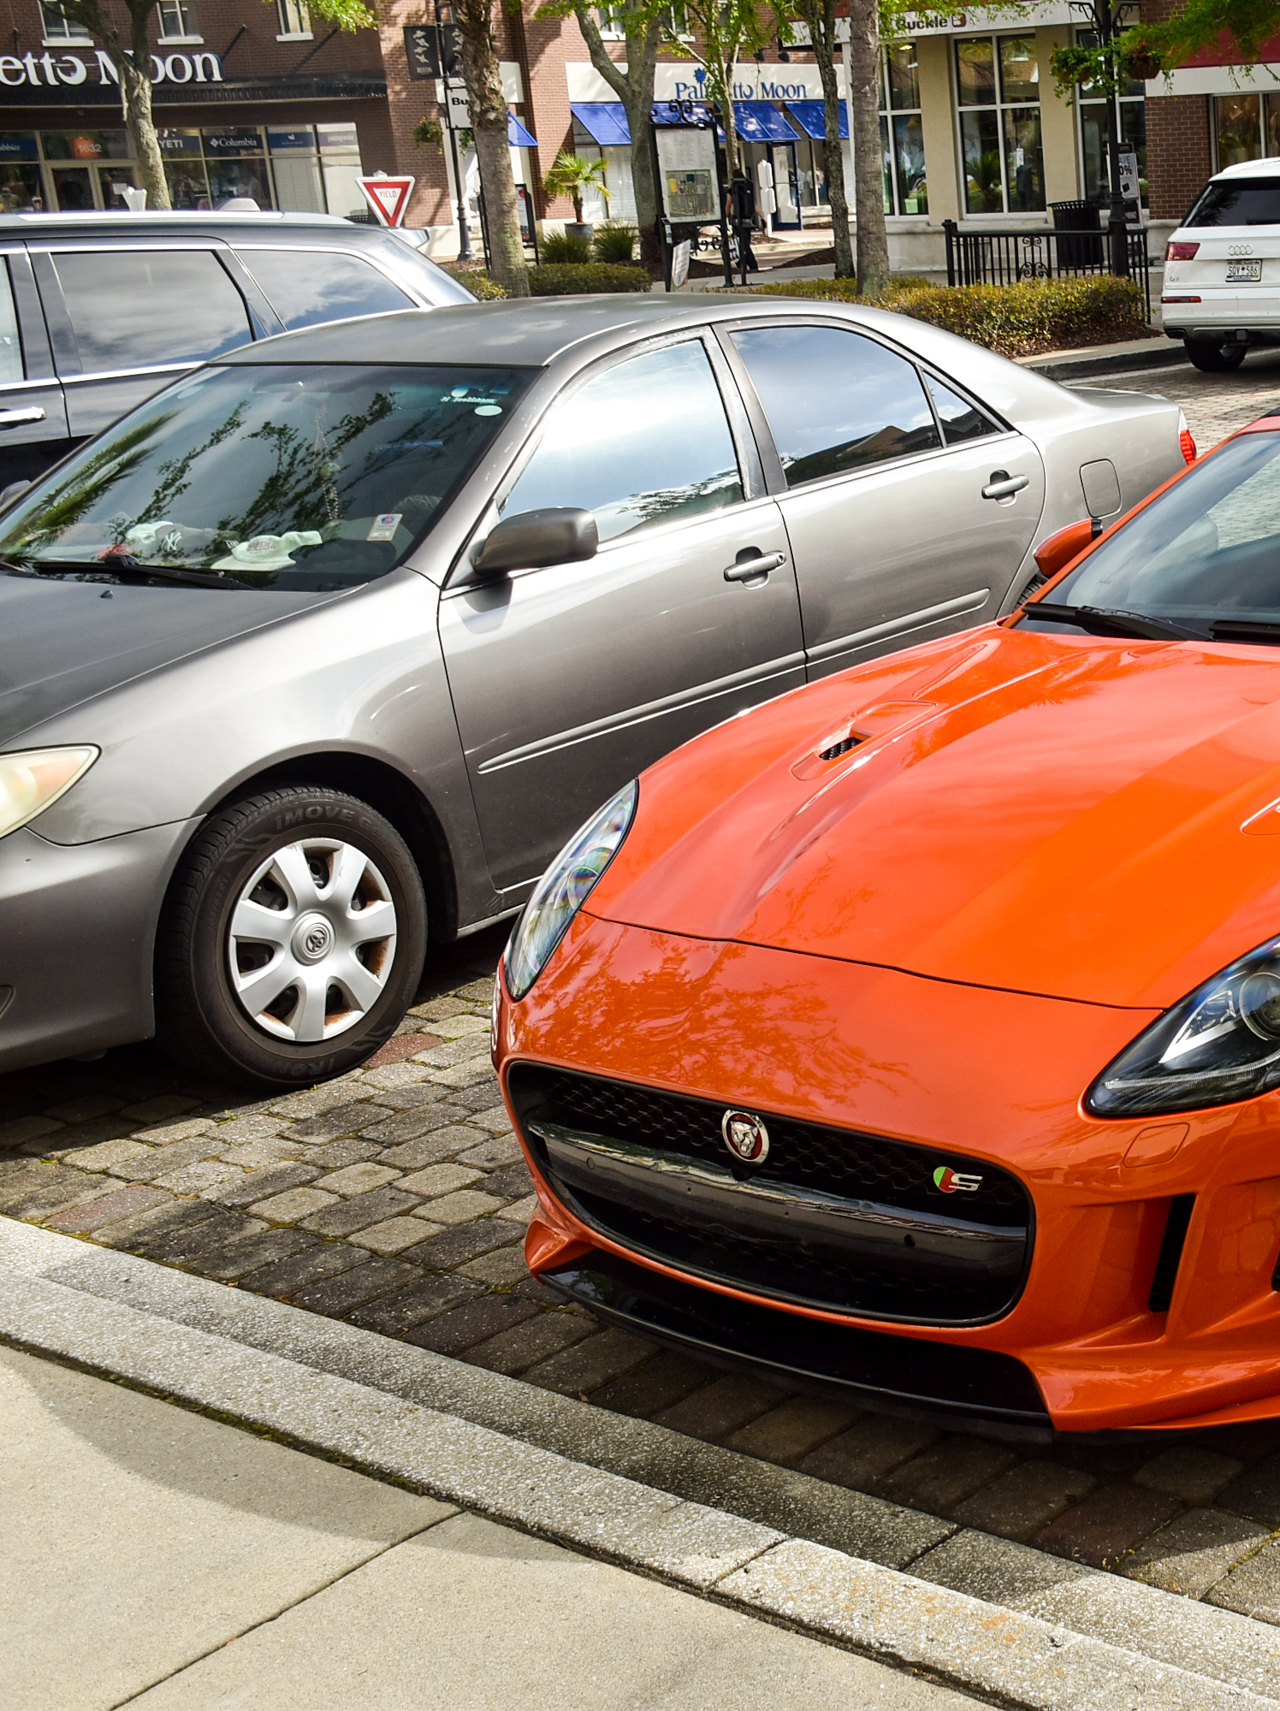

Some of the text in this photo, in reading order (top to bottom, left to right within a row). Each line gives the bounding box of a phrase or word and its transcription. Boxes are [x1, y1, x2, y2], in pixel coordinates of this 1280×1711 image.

[761, 82, 808, 99] Moon
[159, 139, 184, 149] YETI
[218, 138, 258, 148] Columbia
[1119, 165, 1133, 176] 0%
[378, 189, 398, 199] YIELD
[948, 1172, 983, 1192] S
